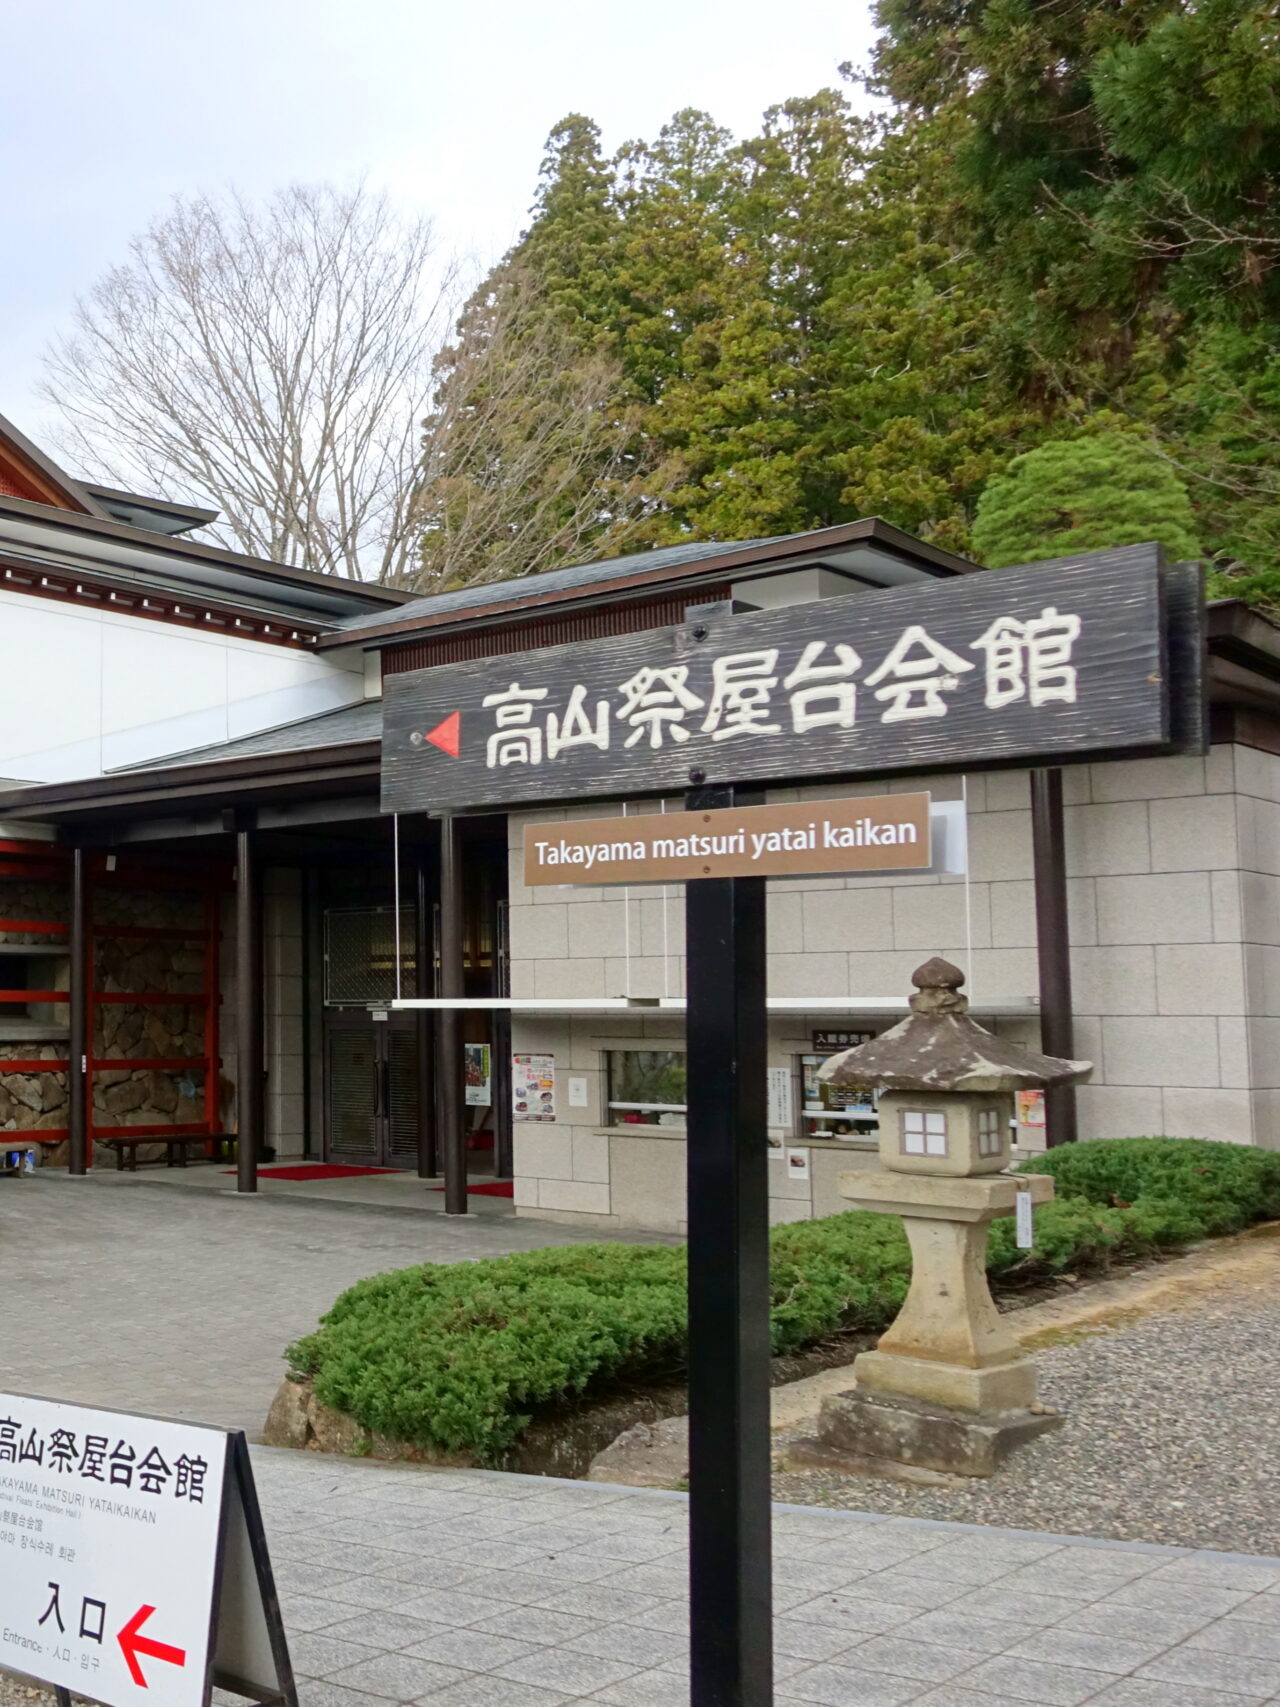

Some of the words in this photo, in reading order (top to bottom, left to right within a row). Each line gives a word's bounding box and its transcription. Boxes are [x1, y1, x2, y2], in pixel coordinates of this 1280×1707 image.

[483, 607, 1081, 769] 高山祭屋台会館
[535, 840, 646, 869] Takayama
[652, 828, 745, 858] matsuri
[751, 823, 817, 860] yatai
[823, 817, 917, 848] kaikan
[42, 1486, 85, 1507] MATSURI
[89, 1497, 157, 1524] YATAIKAIKAN
[38, 1581, 106, 1645] 入口
[3, 1627, 43, 1653] Entrance
